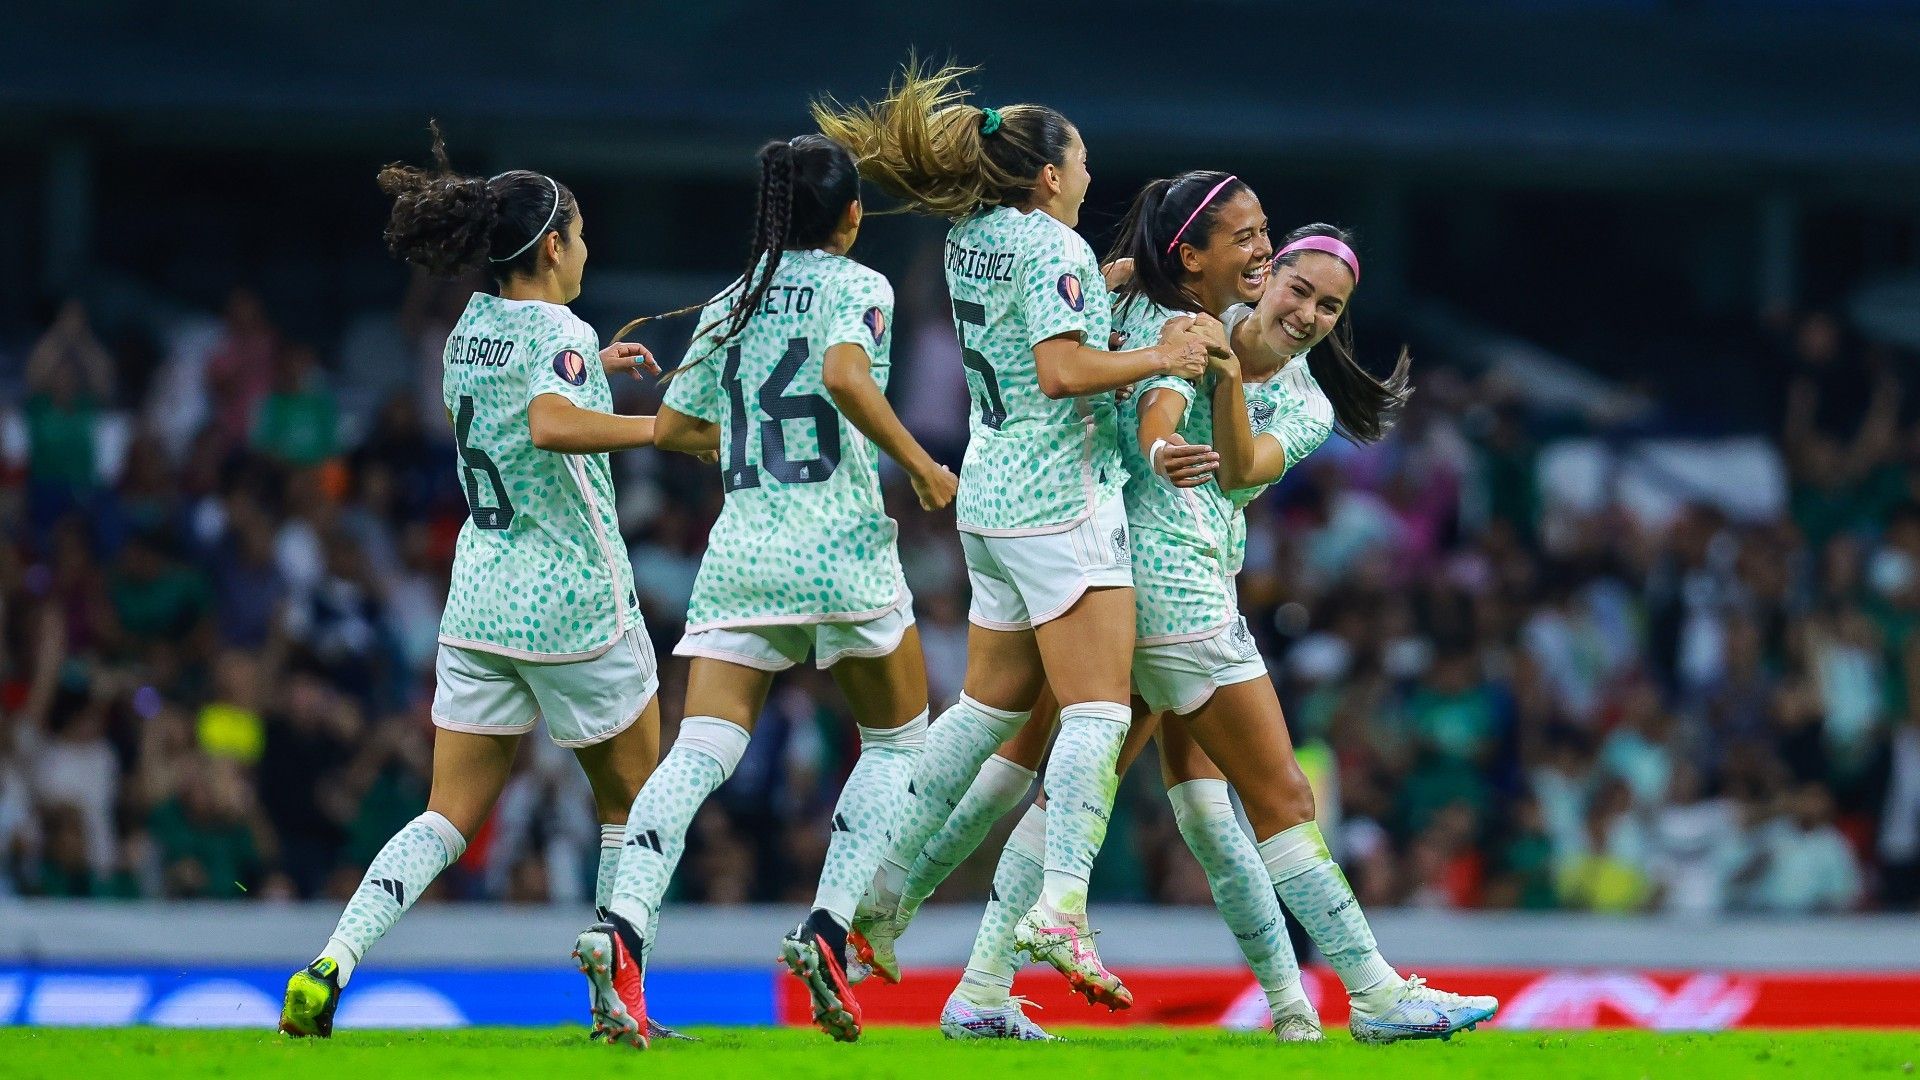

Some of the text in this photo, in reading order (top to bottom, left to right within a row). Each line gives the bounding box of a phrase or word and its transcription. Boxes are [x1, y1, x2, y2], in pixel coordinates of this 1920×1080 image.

[449, 335, 515, 367] DELGADO
[720, 336, 842, 493] 16
[953, 298, 1007, 431] 5
[455, 395, 516, 530] 6
